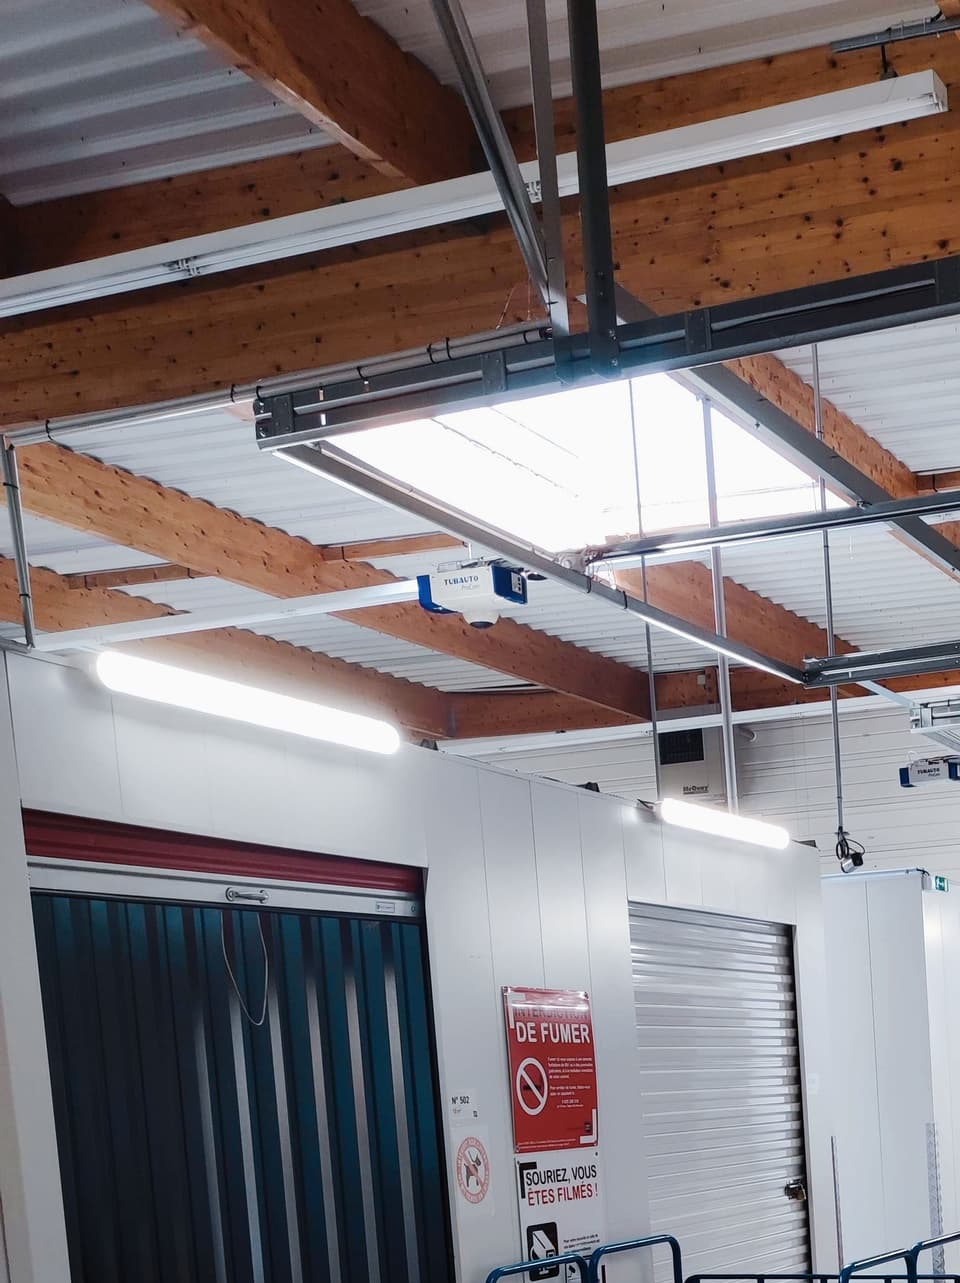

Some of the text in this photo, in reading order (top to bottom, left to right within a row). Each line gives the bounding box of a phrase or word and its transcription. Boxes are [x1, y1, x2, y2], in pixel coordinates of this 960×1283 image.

[516, 1021, 591, 1044] DE FUMER
[525, 1164, 597, 1186] SOURIEZ, VOUS
[527, 1187, 555, 1207] ÊTES
[557, 1180, 593, 1202] FILMÉS
